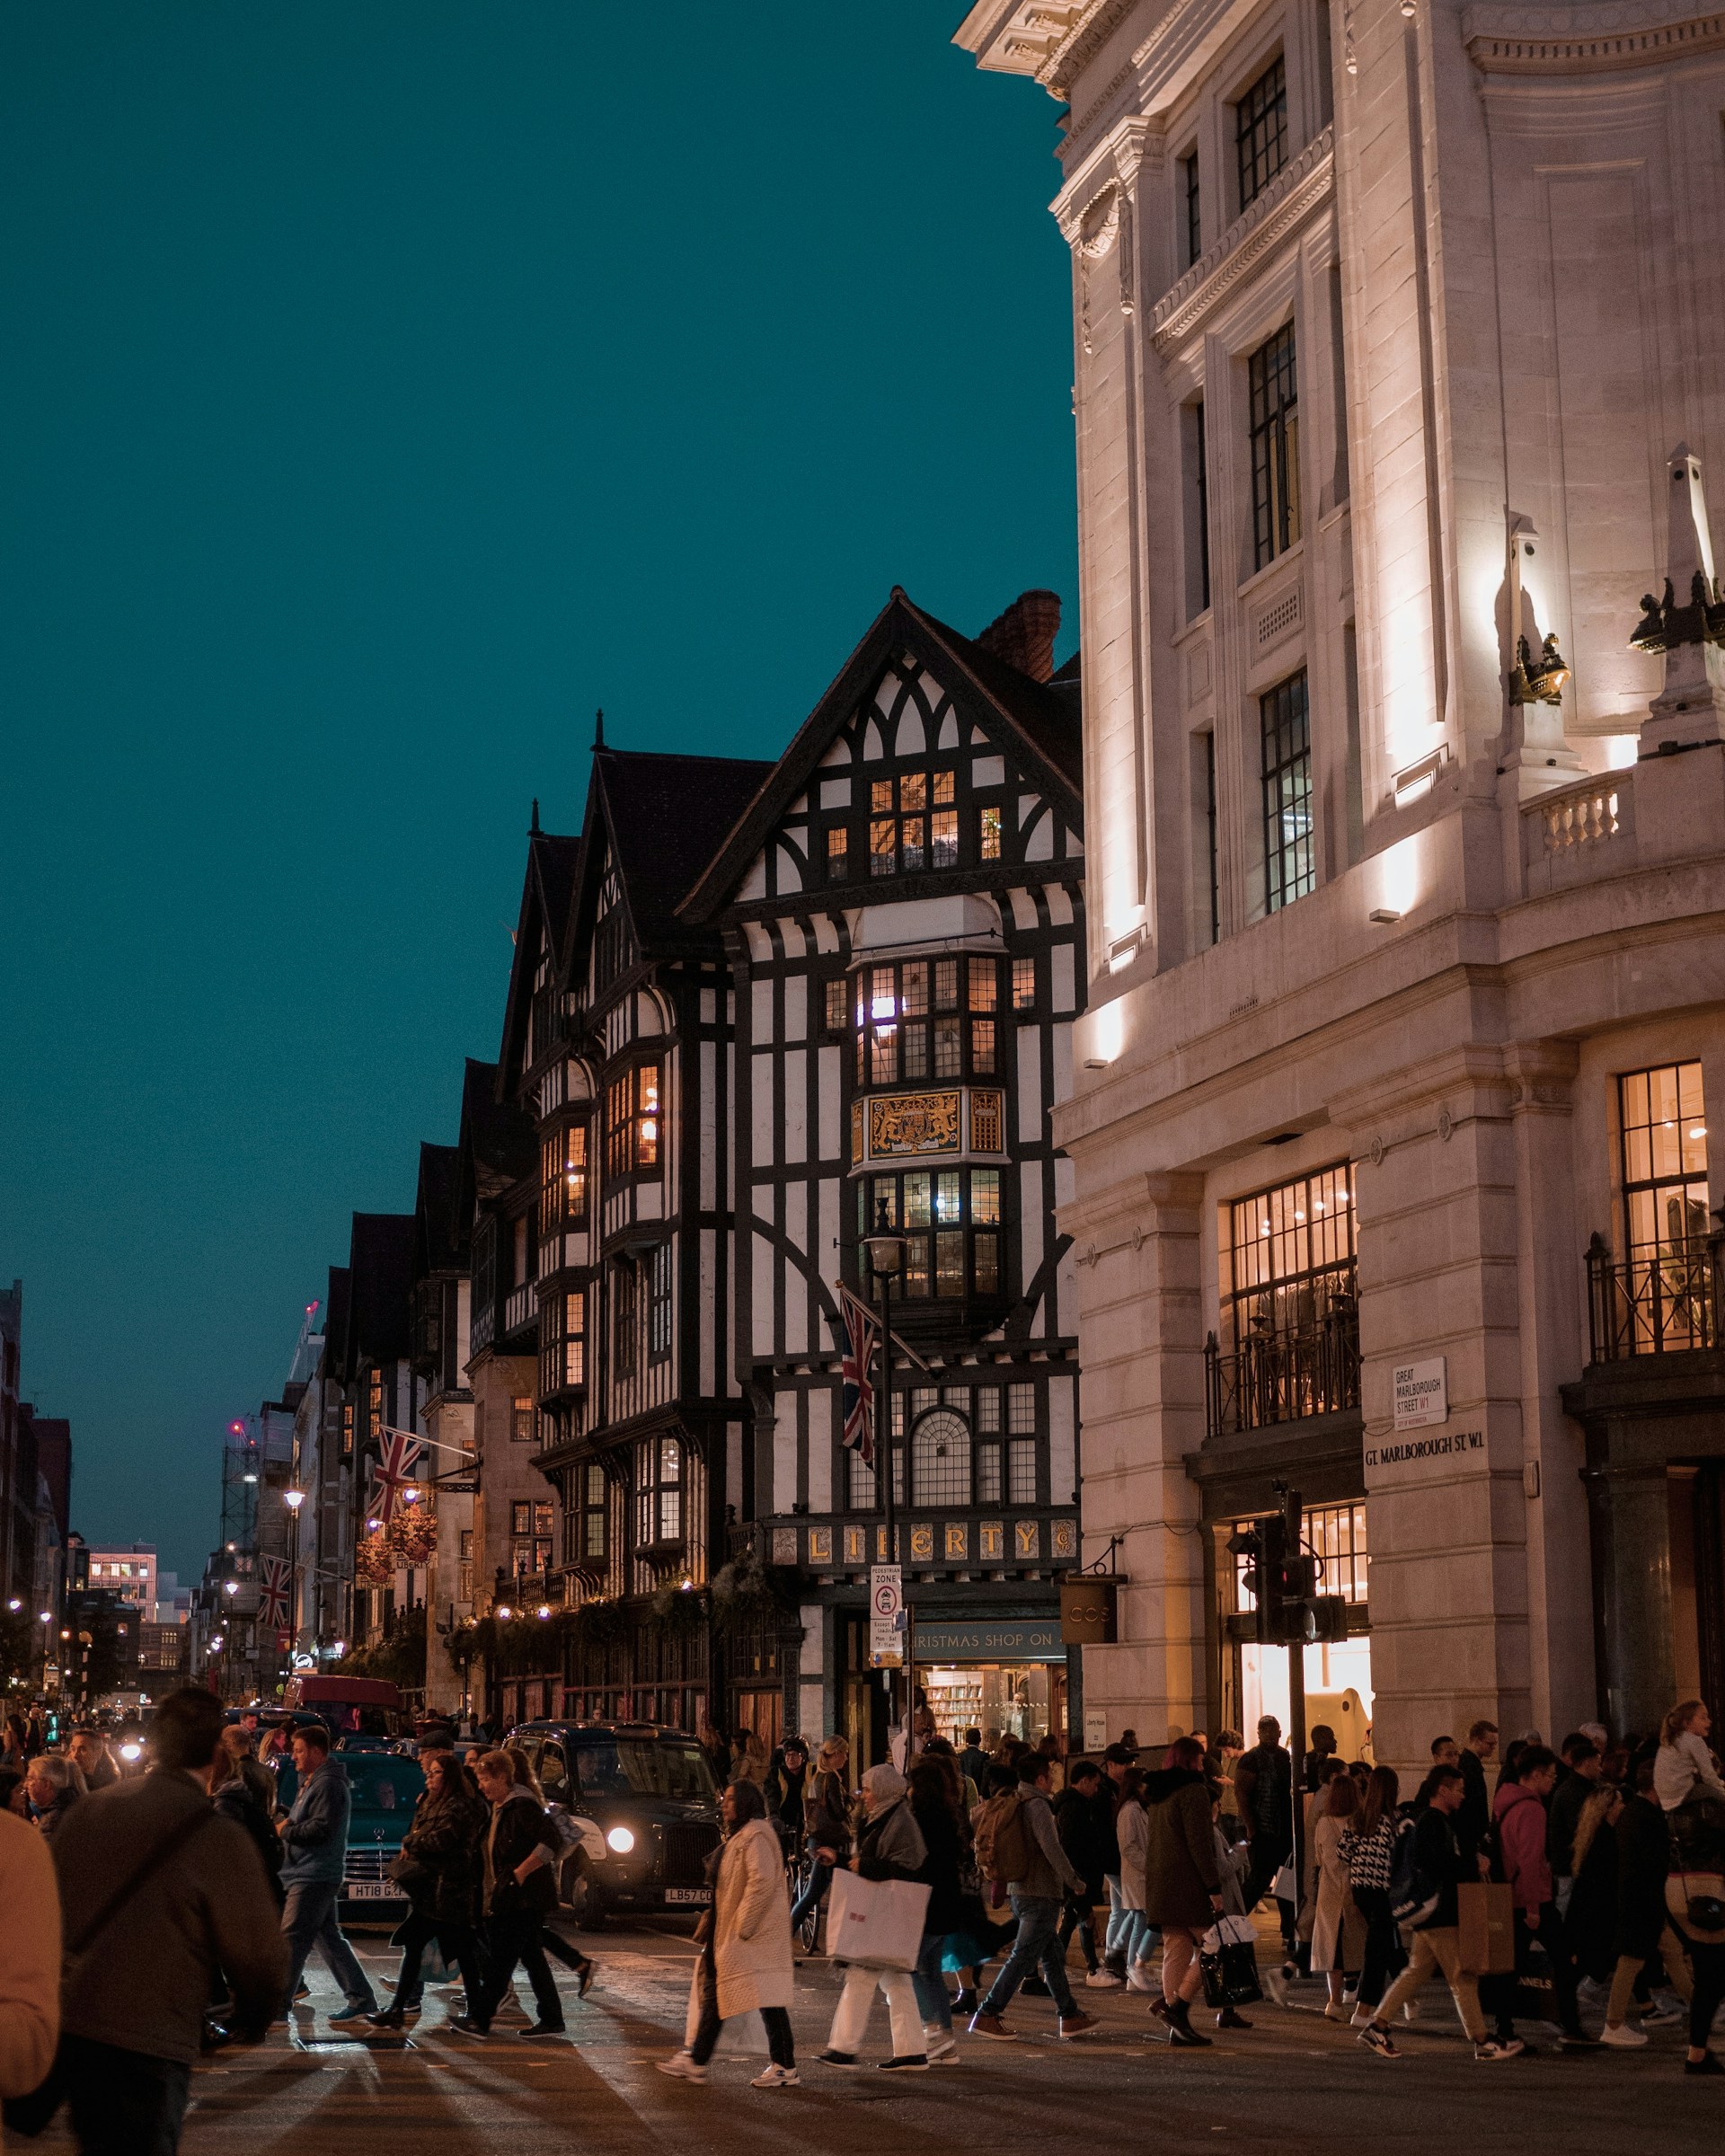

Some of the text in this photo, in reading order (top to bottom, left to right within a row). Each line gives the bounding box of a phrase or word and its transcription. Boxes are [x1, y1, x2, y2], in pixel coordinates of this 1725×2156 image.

[1395, 1368, 1414, 1384] GREAT
[1396, 1378, 1441, 1399] MARLBOROUGH
[1397, 1396, 1429, 1414] STREET W1
[1381, 1436, 1452, 1463] MARLBOROUGH
[876, 1575, 897, 1583] ZONE
[1070, 1606, 1110, 1622] COS
[985, 1633, 1022, 1647] SHOP
[1030, 1632, 1052, 1646] ON
[356, 1886, 381, 1896] HT18
[670, 1889, 697, 1900] LB57
[1518, 1976, 1552, 1990] NNELS
